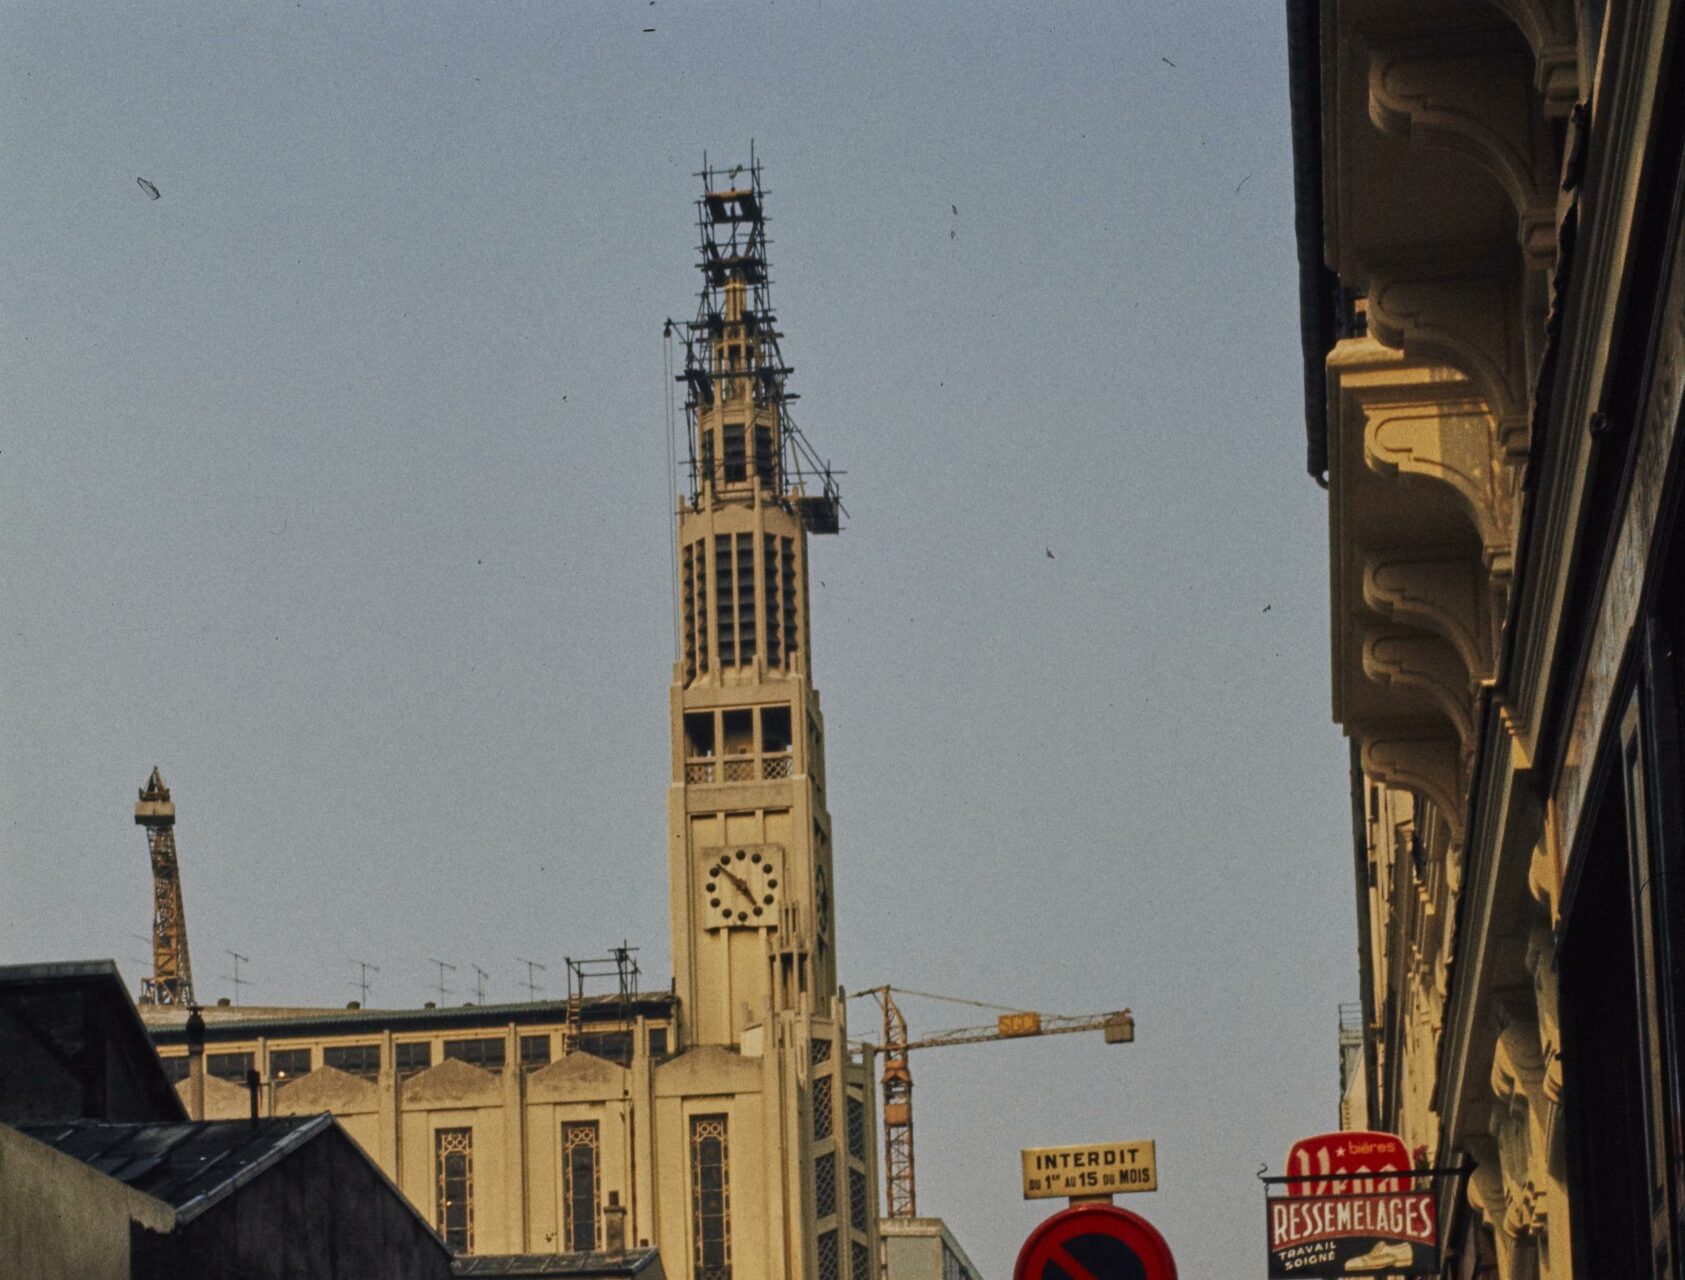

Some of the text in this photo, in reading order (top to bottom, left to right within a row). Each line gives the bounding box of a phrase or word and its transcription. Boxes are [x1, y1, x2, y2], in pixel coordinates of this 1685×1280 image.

[1036, 1148, 1139, 1170] INTERDIT
[1029, 1179, 1041, 1191] DU
[1065, 1176, 1076, 1188] AU
[1079, 1171, 1098, 1187] 15
[1103, 1173, 1115, 1186] DU
[1119, 1167, 1150, 1184] MOIS
[1273, 1197, 1432, 1245] RESSEMELAGES
[1278, 1241, 1336, 1261] TRAVAIL
